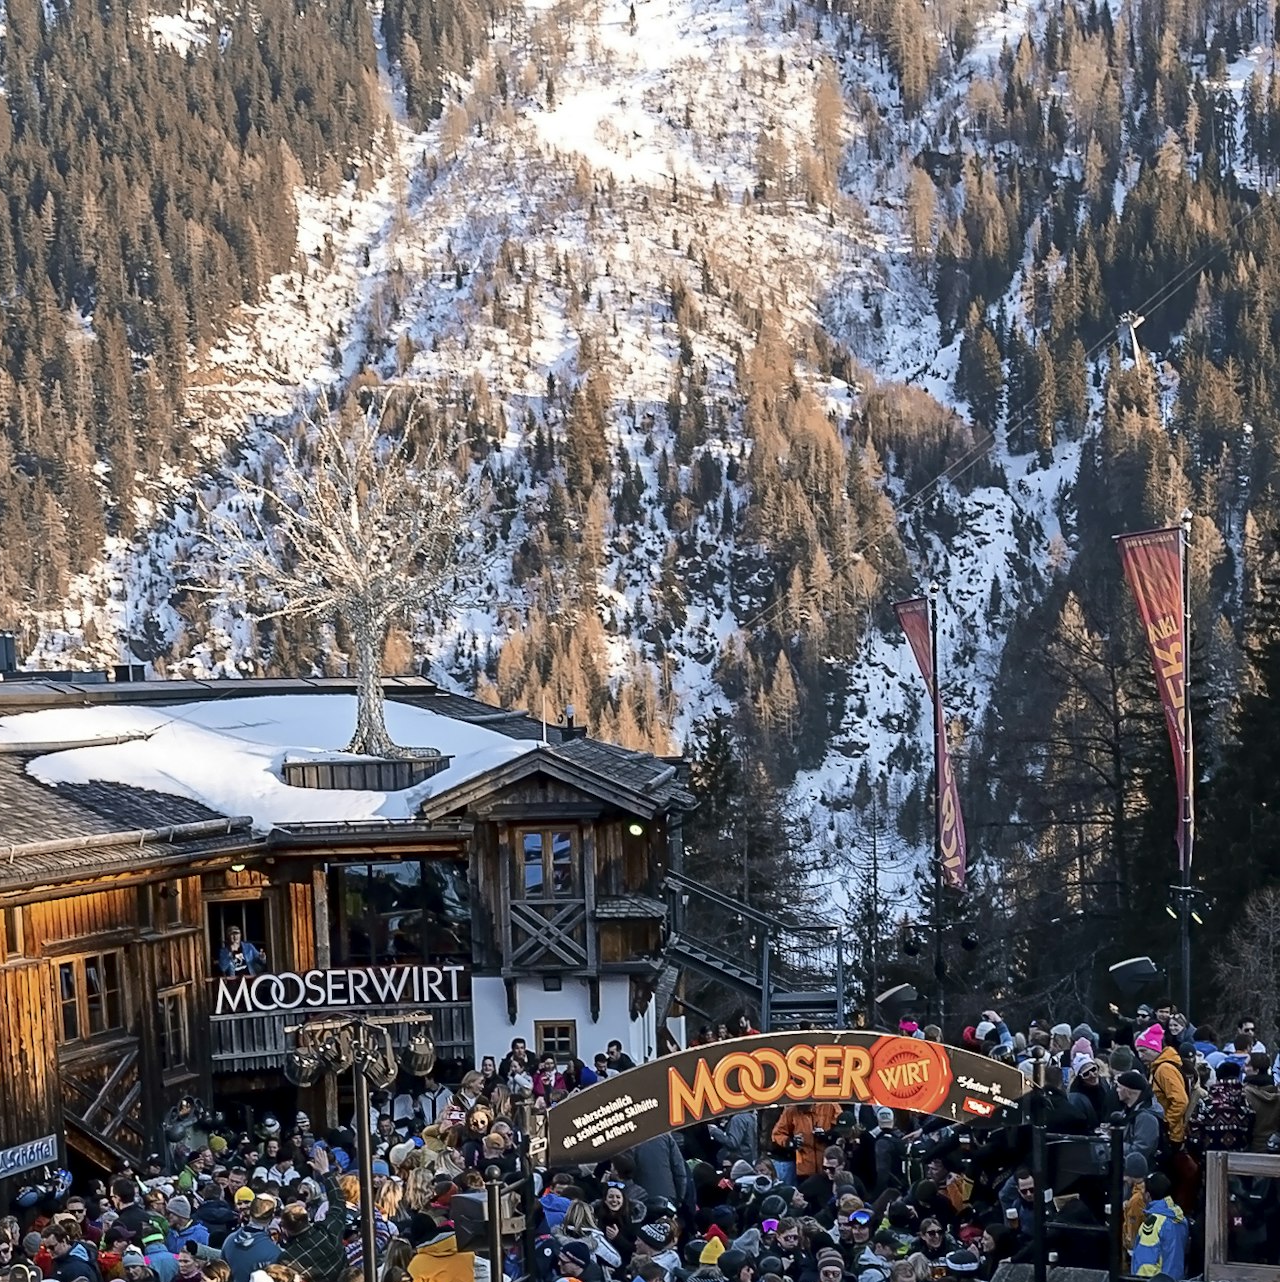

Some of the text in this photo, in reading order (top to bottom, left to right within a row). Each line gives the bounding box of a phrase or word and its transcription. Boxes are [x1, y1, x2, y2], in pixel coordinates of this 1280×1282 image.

[215, 966, 465, 1014] MOOSERWIRT
[669, 1045, 872, 1126] MOOSER
[877, 1060, 931, 1092] WIRT
[572, 1095, 634, 1129] Wahrscheinlich
[563, 1134, 578, 1149] die
[592, 1119, 638, 1148] am Arlberg.
[6, 1138, 54, 1169] Schöffel
